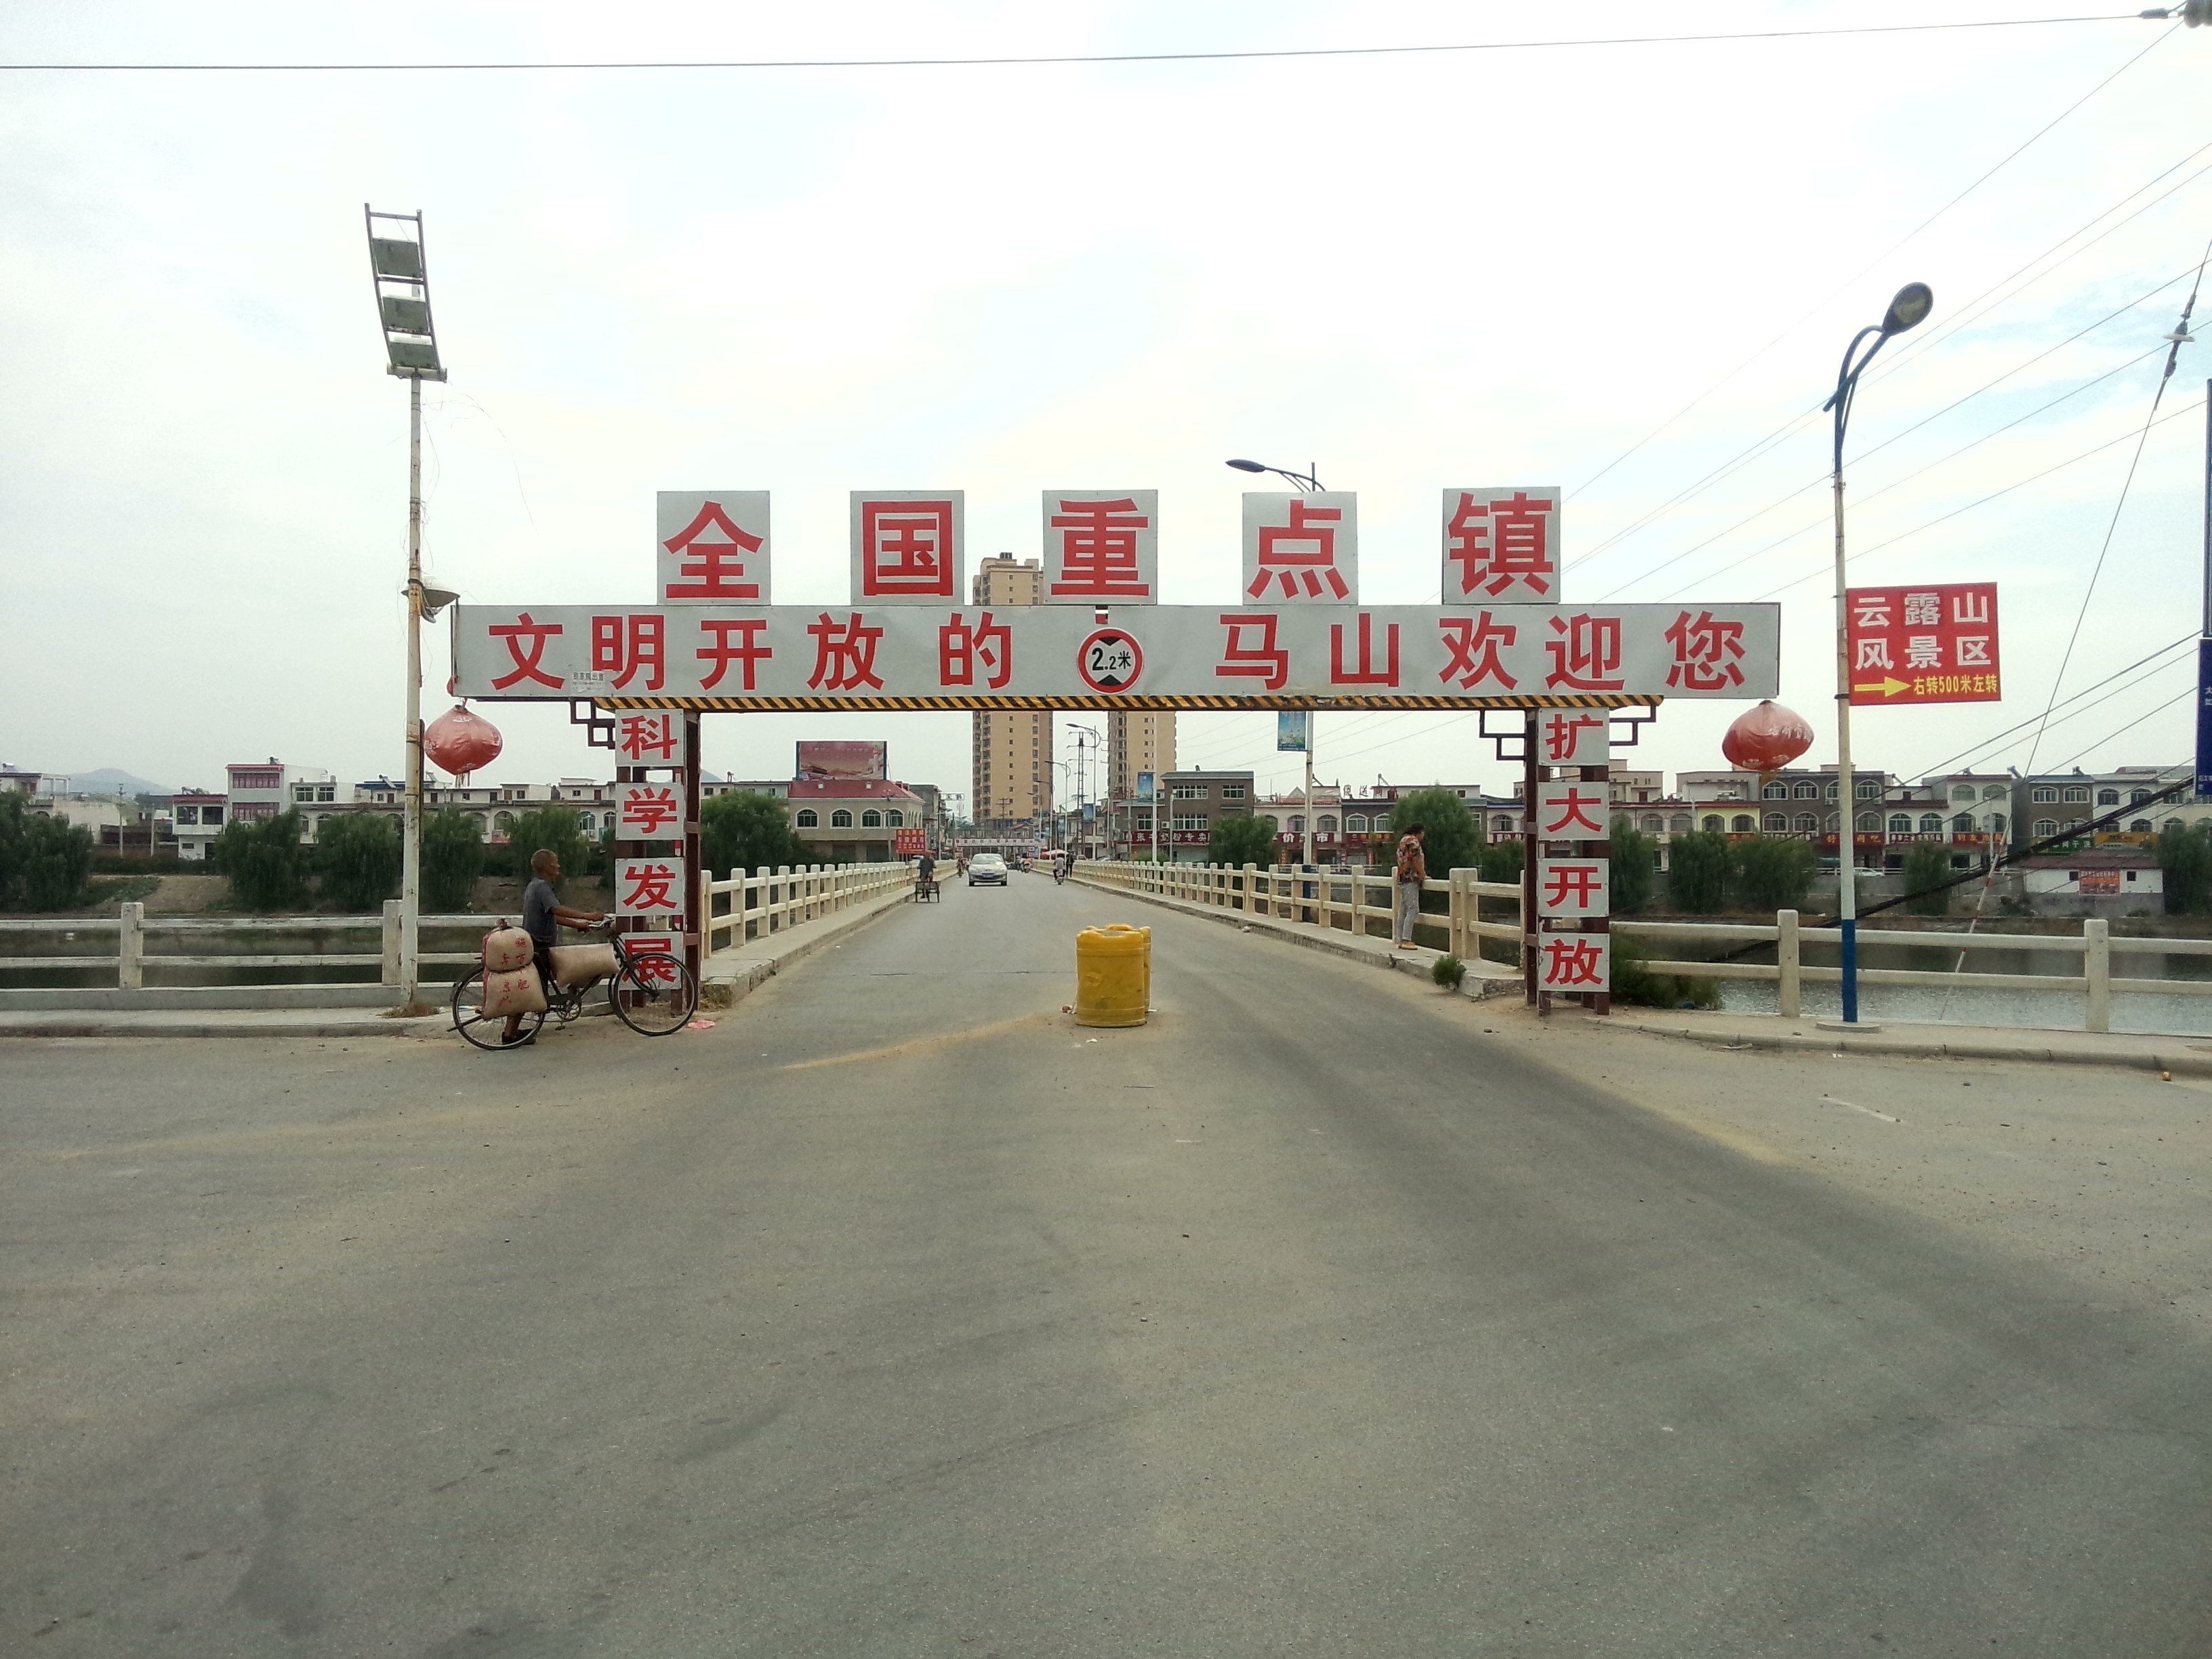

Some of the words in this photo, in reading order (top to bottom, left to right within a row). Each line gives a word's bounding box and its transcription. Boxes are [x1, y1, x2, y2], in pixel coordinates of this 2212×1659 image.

[661, 491, 1555, 600] 全国重点镇
[1853, 592, 1988, 628] 云露山
[487, 611, 1012, 691] 文明开放的
[1091, 647, 1132, 671] 2.2米
[1214, 610, 1747, 691] 马山欢迎您
[1855, 635, 1992, 671] 风景区
[1913, 673, 1998, 696] 右转500米左转
[1543, 712, 1604, 985] 扩大开放
